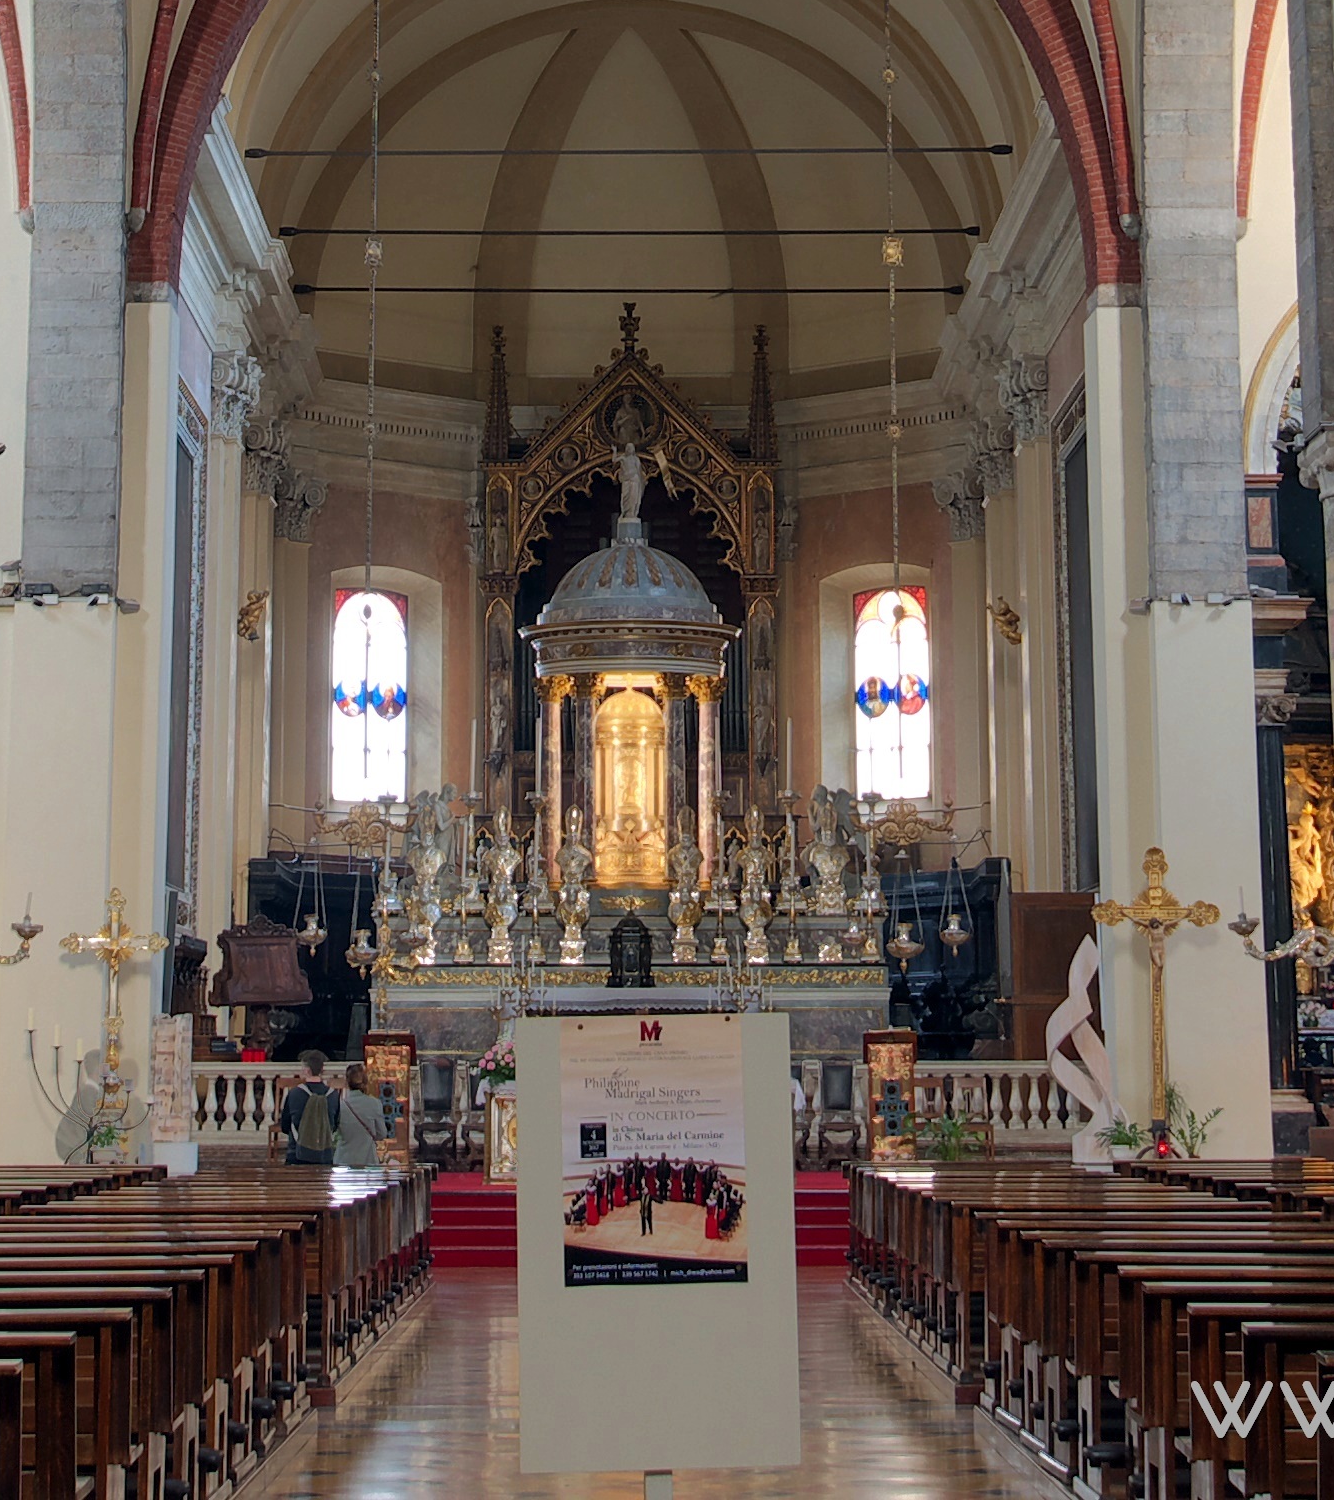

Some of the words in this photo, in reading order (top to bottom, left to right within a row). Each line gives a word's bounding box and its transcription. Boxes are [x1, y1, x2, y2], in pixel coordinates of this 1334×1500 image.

[584, 1077, 641, 1092] Philippine
[605, 1087, 657, 1100] Madrigal
[658, 1085, 702, 1101] Singers
[610, 1112, 624, 1122] IN
[627, 1109, 696, 1121] CONCERTO
[612, 1132, 623, 1142] di
[624, 1132, 634, 1141] S.
[636, 1131, 665, 1141] Maria
[667, 1130, 682, 1140] del
[684, 1129, 725, 1140] Carmine
